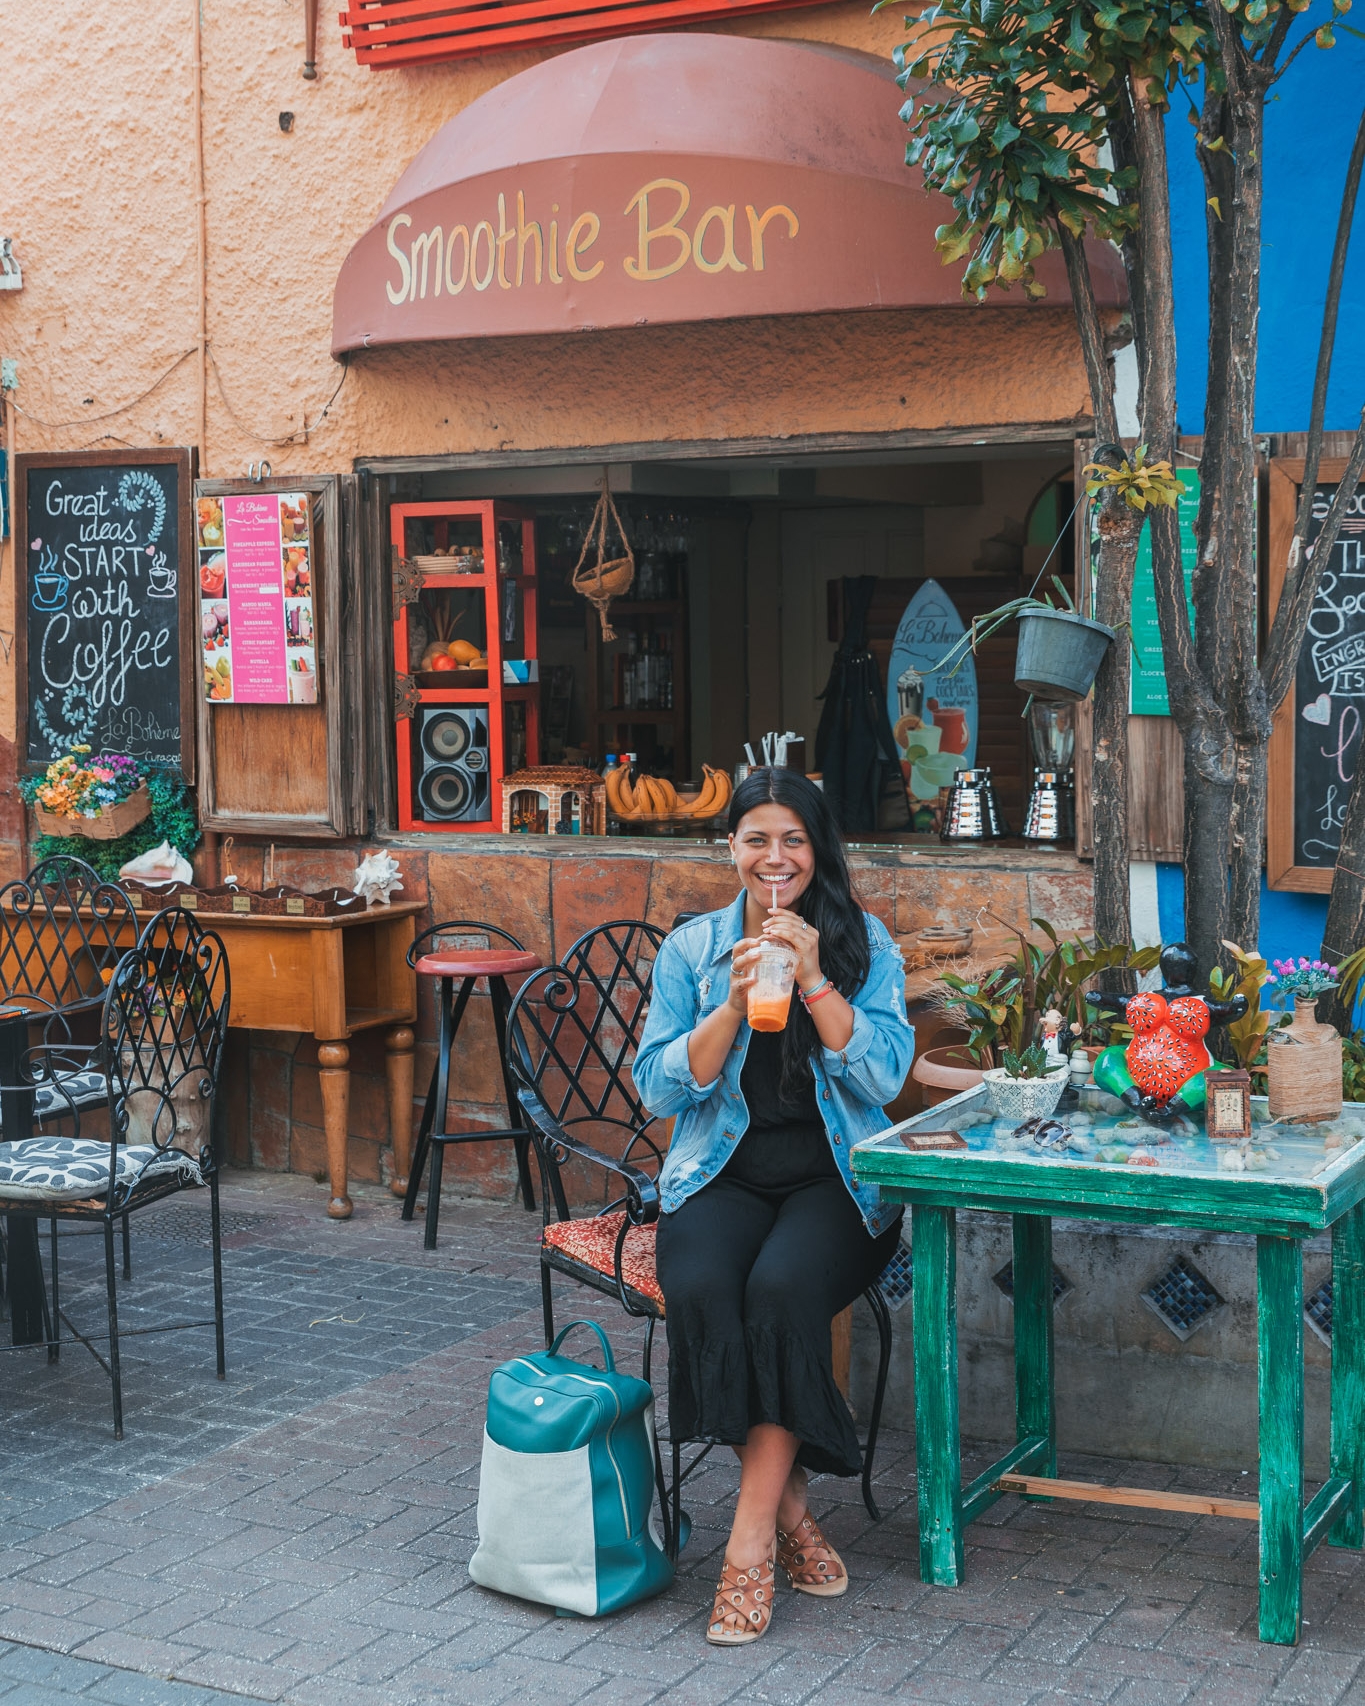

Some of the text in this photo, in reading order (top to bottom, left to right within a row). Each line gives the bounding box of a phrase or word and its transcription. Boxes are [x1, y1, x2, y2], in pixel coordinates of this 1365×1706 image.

[386, 178, 799, 305] Smoothie Bar
[46, 480, 108, 516] Great
[79, 517, 137, 543] ideas
[62, 543, 144, 580] START
[72, 580, 140, 618] with
[41, 612, 171, 706] Coffee
[101, 706, 126, 744] La
